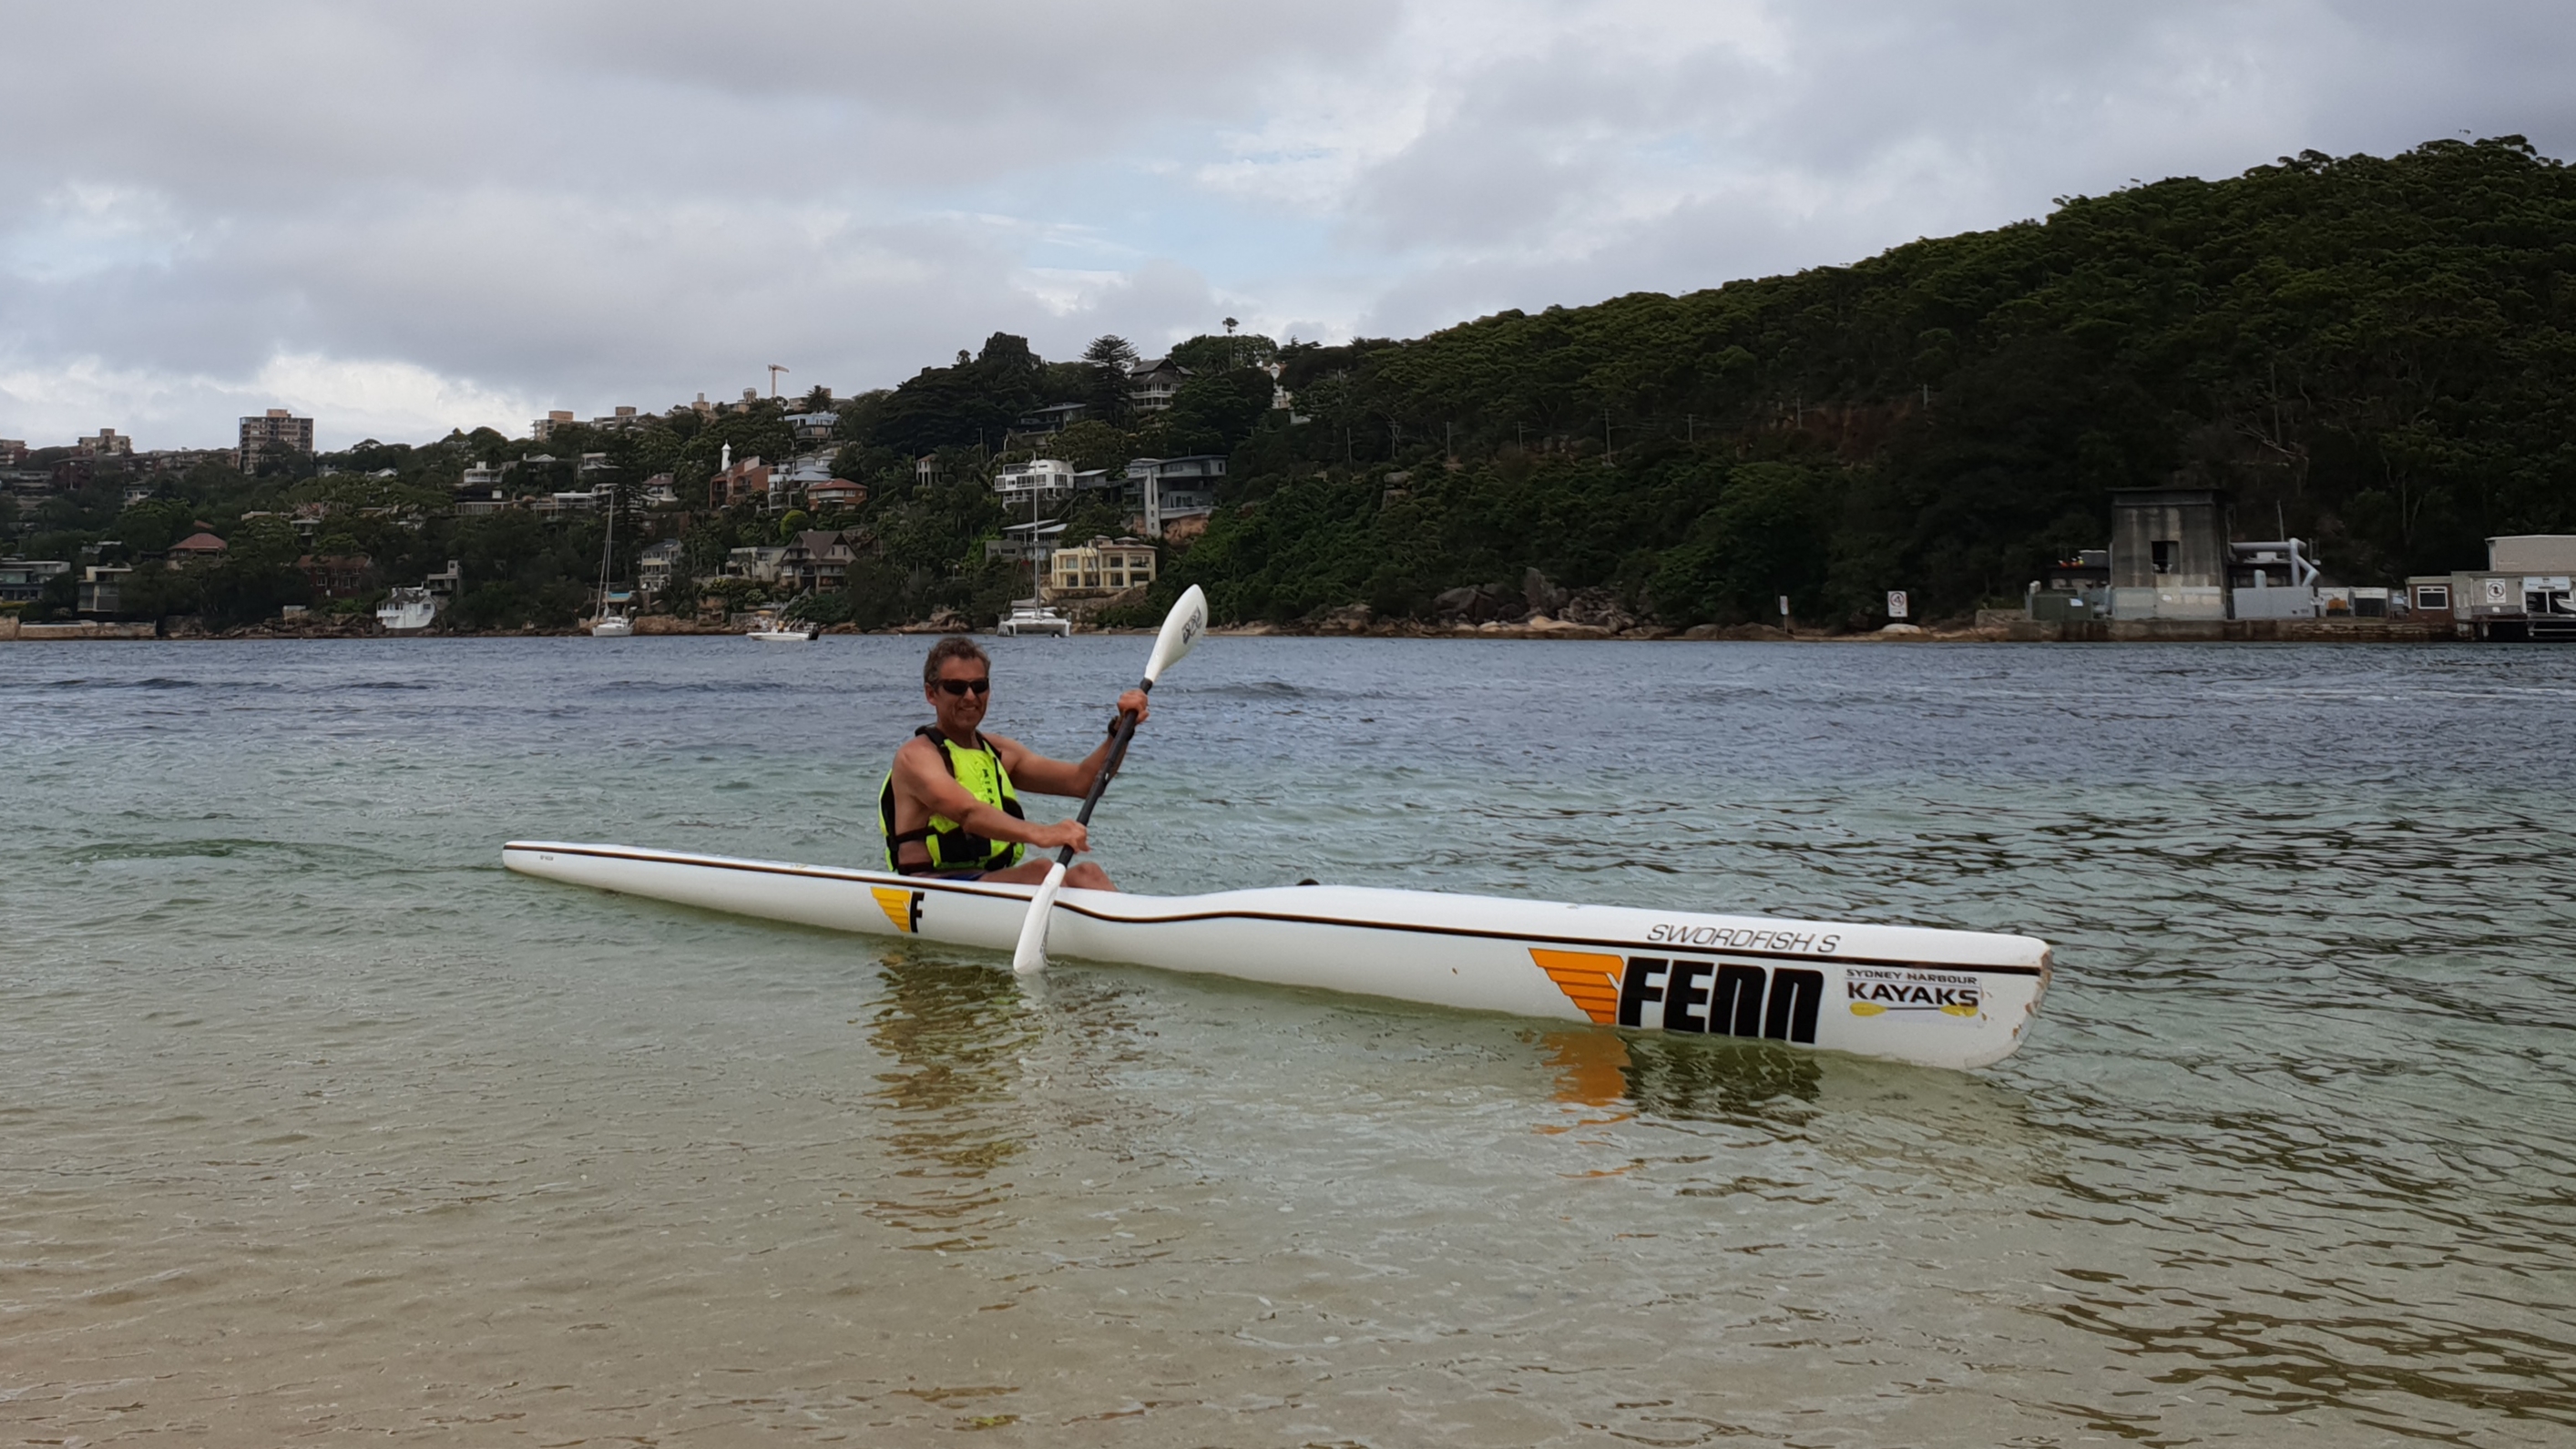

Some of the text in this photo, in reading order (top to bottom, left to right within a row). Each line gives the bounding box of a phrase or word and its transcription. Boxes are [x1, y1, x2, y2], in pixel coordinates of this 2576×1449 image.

[909, 891, 925, 934] F
[1647, 923, 1841, 953] SWORDFISH S
[1846, 969, 1978, 985] SYDNEY HARBOUR
[1619, 956, 1825, 1044] FENN
[1847, 982, 1978, 1007] KAYAKS
